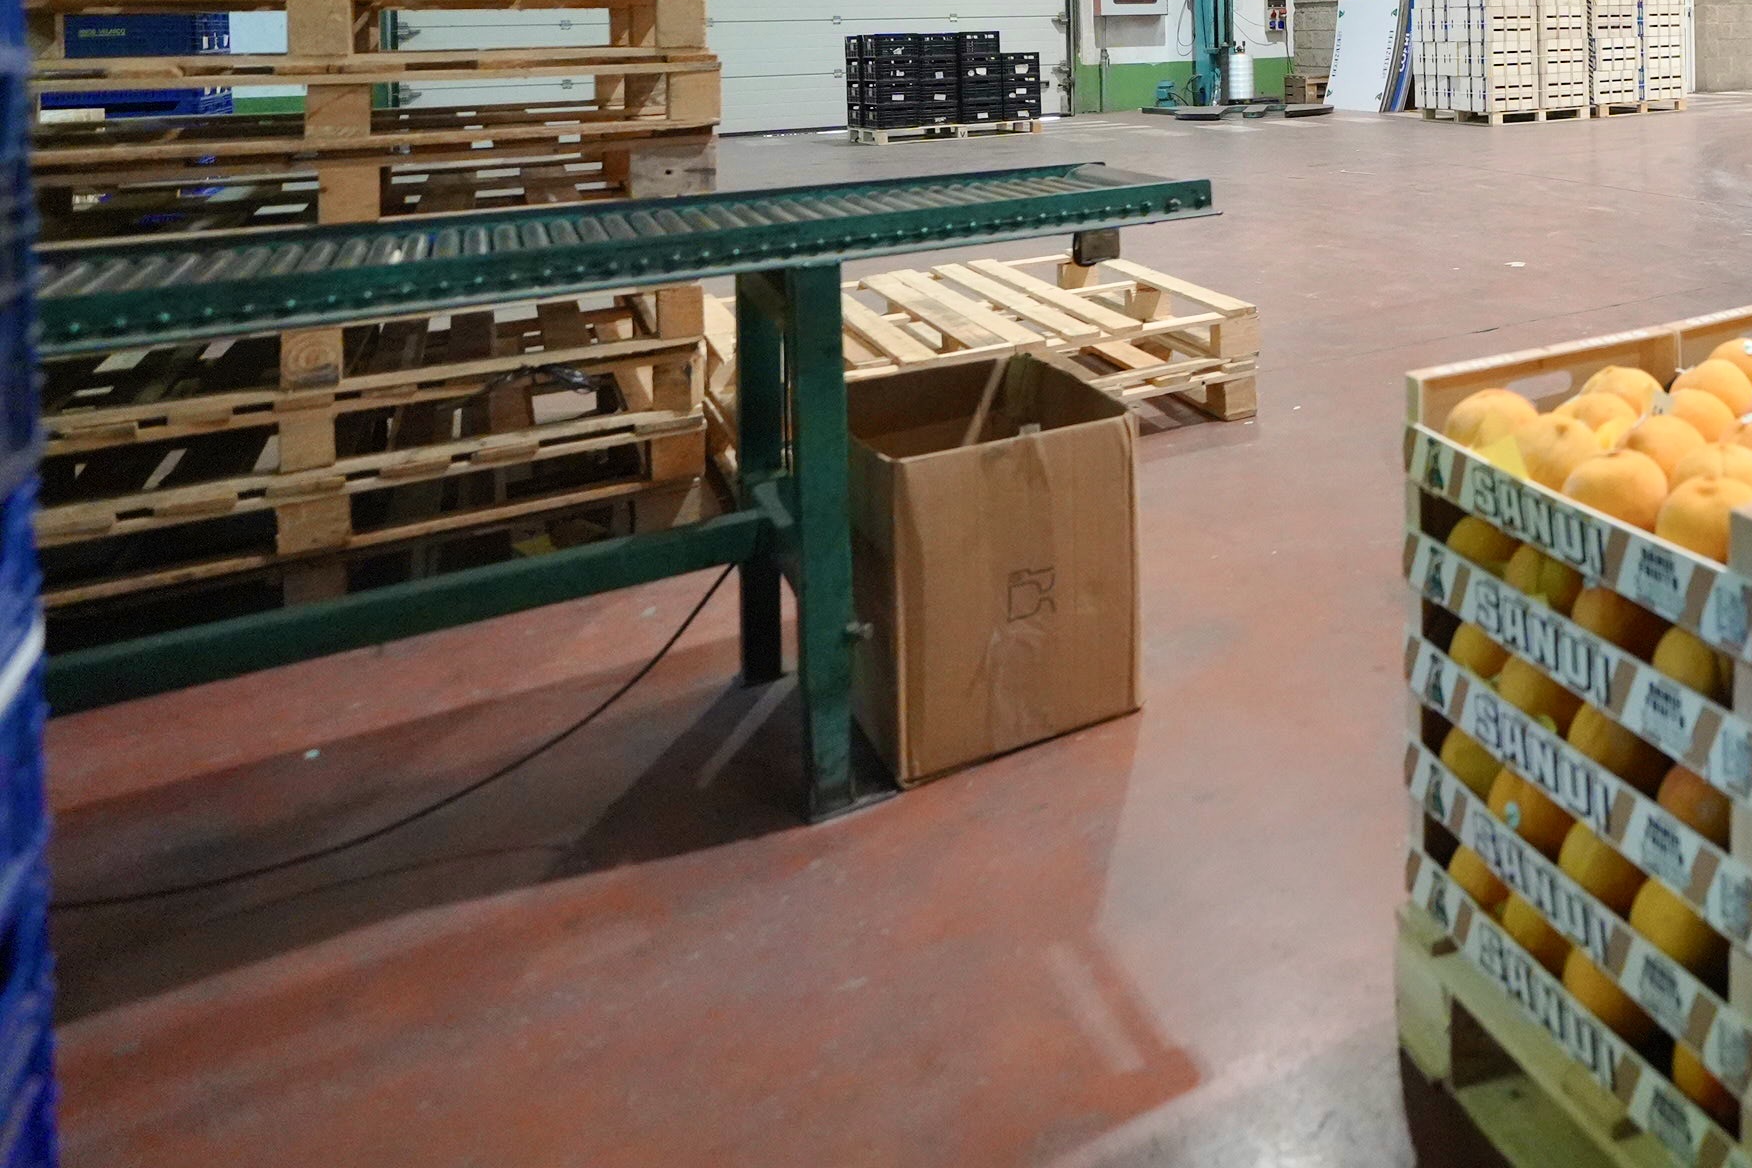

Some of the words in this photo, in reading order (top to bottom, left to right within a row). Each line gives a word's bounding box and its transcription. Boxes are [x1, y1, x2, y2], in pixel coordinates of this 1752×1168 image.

[1473, 463, 1605, 577] SANUI
[1474, 579, 1611, 707] SANUI
[1473, 692, 1612, 834] SANUI
